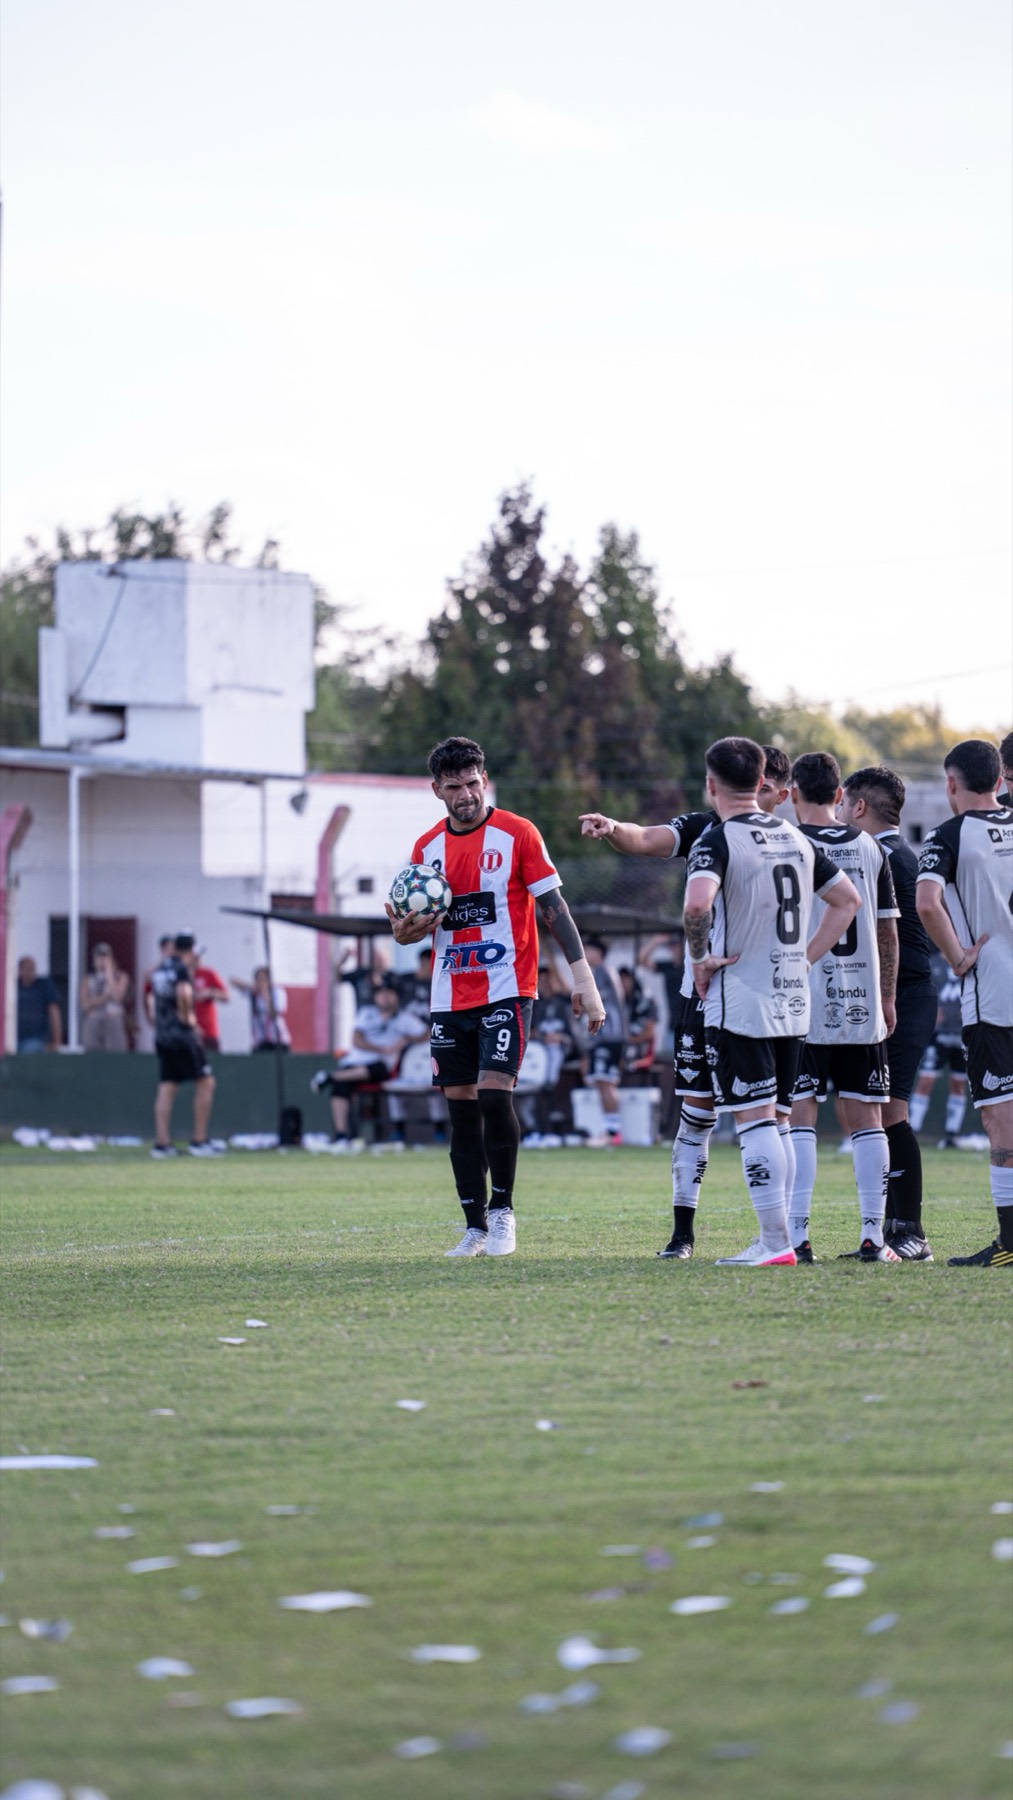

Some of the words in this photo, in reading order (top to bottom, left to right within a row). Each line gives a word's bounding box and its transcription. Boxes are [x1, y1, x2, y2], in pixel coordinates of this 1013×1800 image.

[773, 864, 800, 944] 8
[441, 943, 507, 969] RTO
[496, 1028, 512, 1052] 9
[745, 1163, 770, 1187] PLAN
